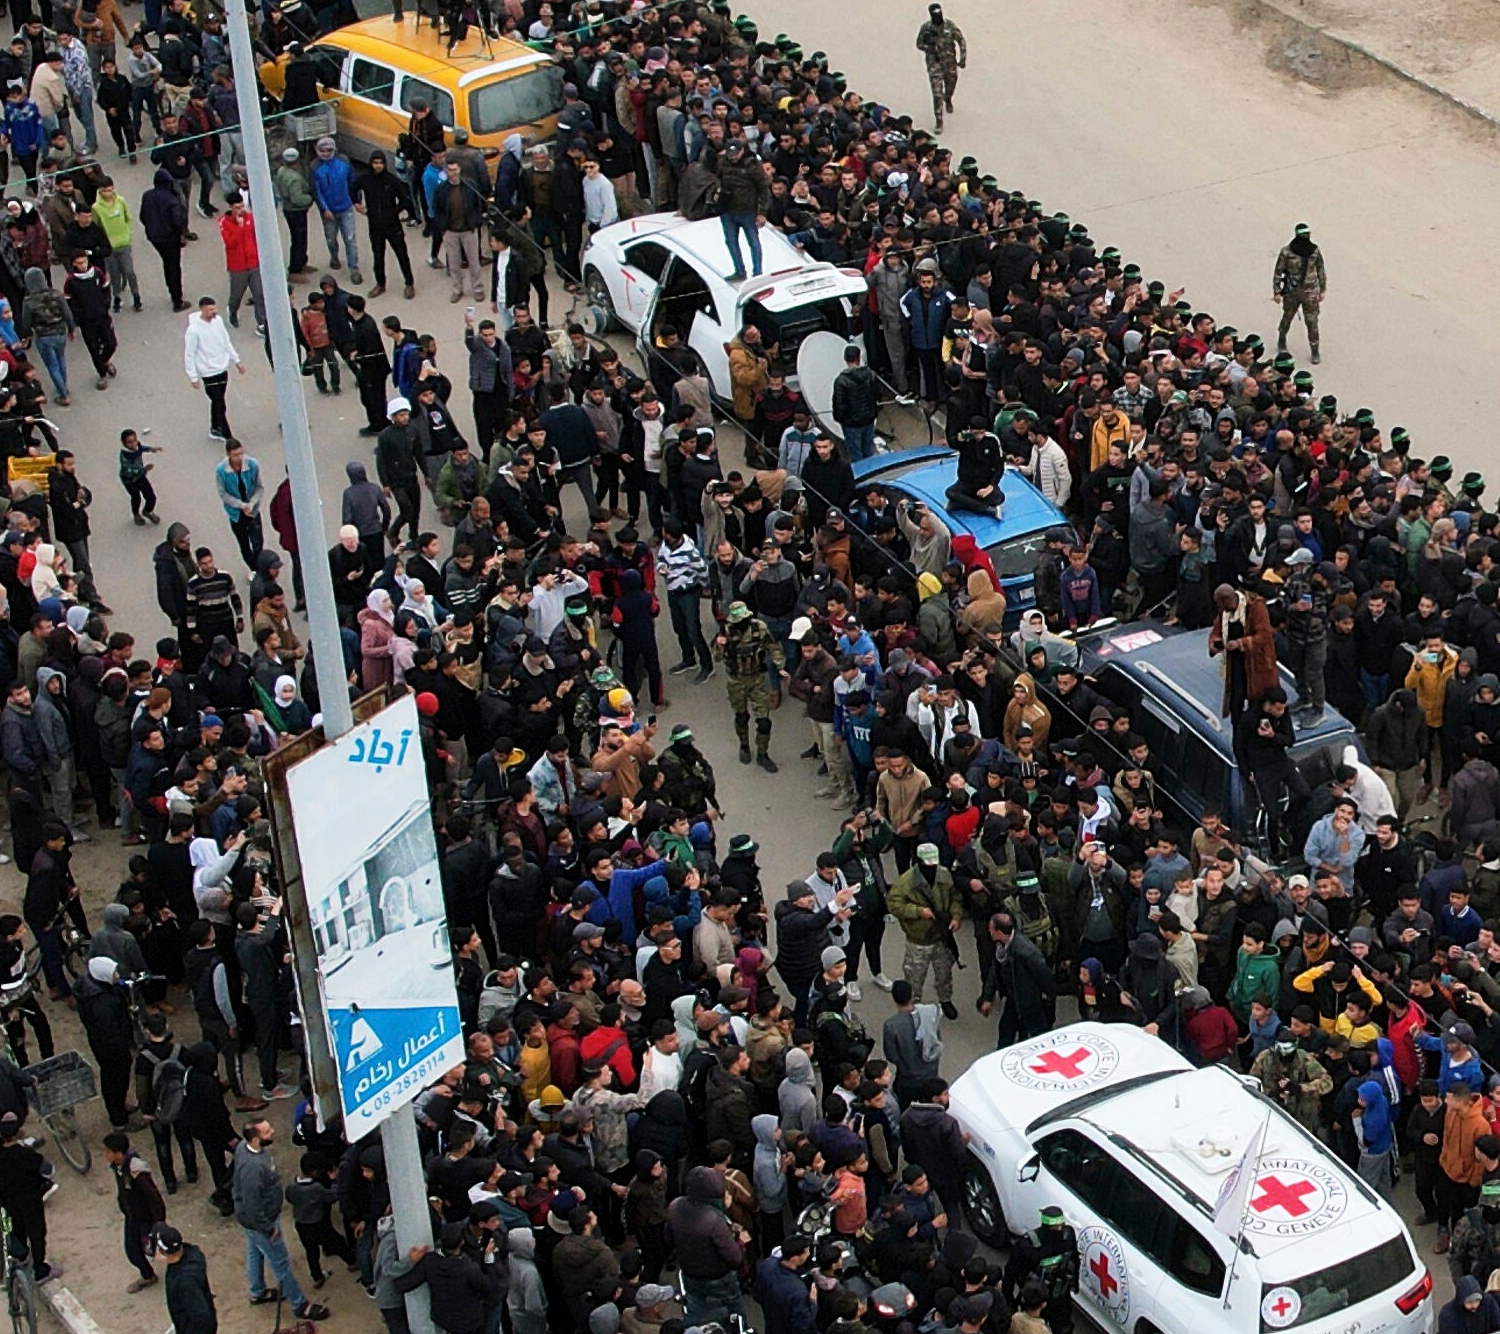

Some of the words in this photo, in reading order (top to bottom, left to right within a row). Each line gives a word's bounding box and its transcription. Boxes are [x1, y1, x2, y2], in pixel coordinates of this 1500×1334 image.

[348, 729, 413, 773] آجاد
[397, 1011, 446, 1069] أعمال
[354, 1060, 394, 1103] رخام
[1276, 1204, 1341, 1234] GENEVE
